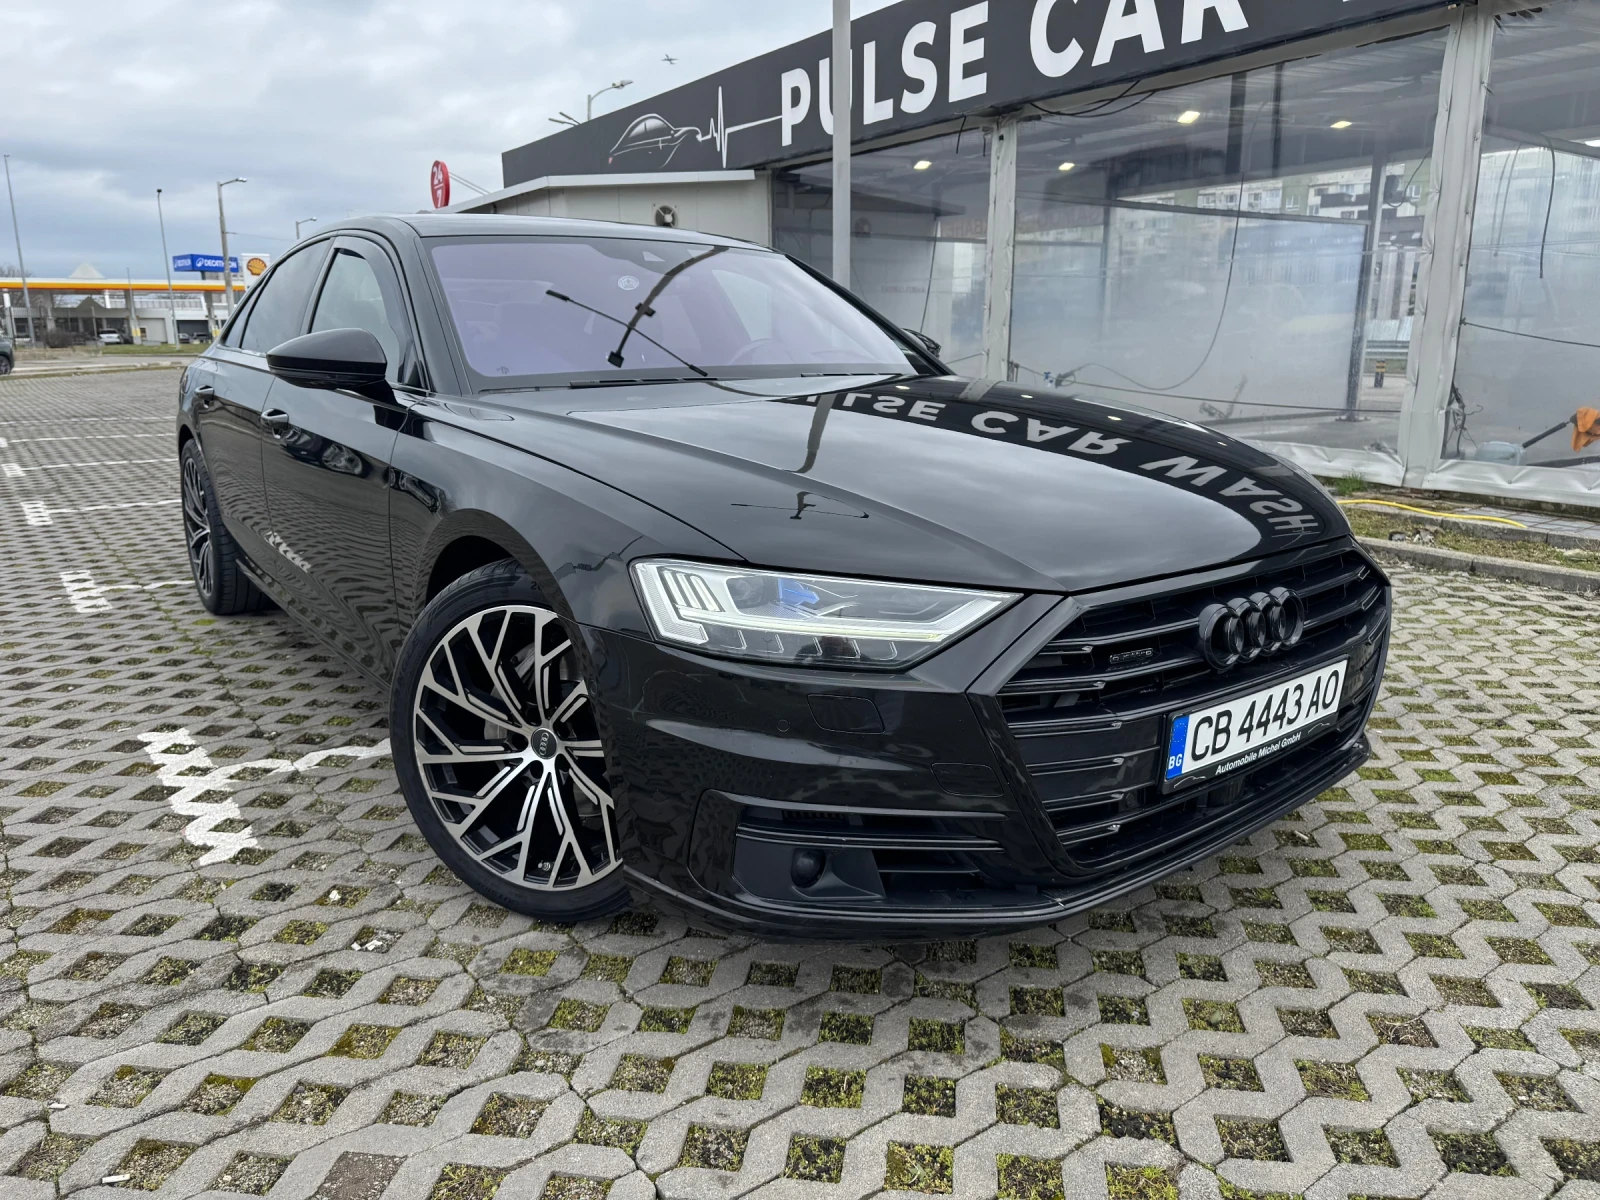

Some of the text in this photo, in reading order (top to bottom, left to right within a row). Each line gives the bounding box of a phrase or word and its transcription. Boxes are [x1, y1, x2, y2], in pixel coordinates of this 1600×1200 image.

[433, 164, 443, 185] 24
[1191, 669, 1340, 762] CB 4443 AO
[1168, 753, 1182, 770] BG
[1215, 732, 1301, 776] Automobile Michel GmbH
